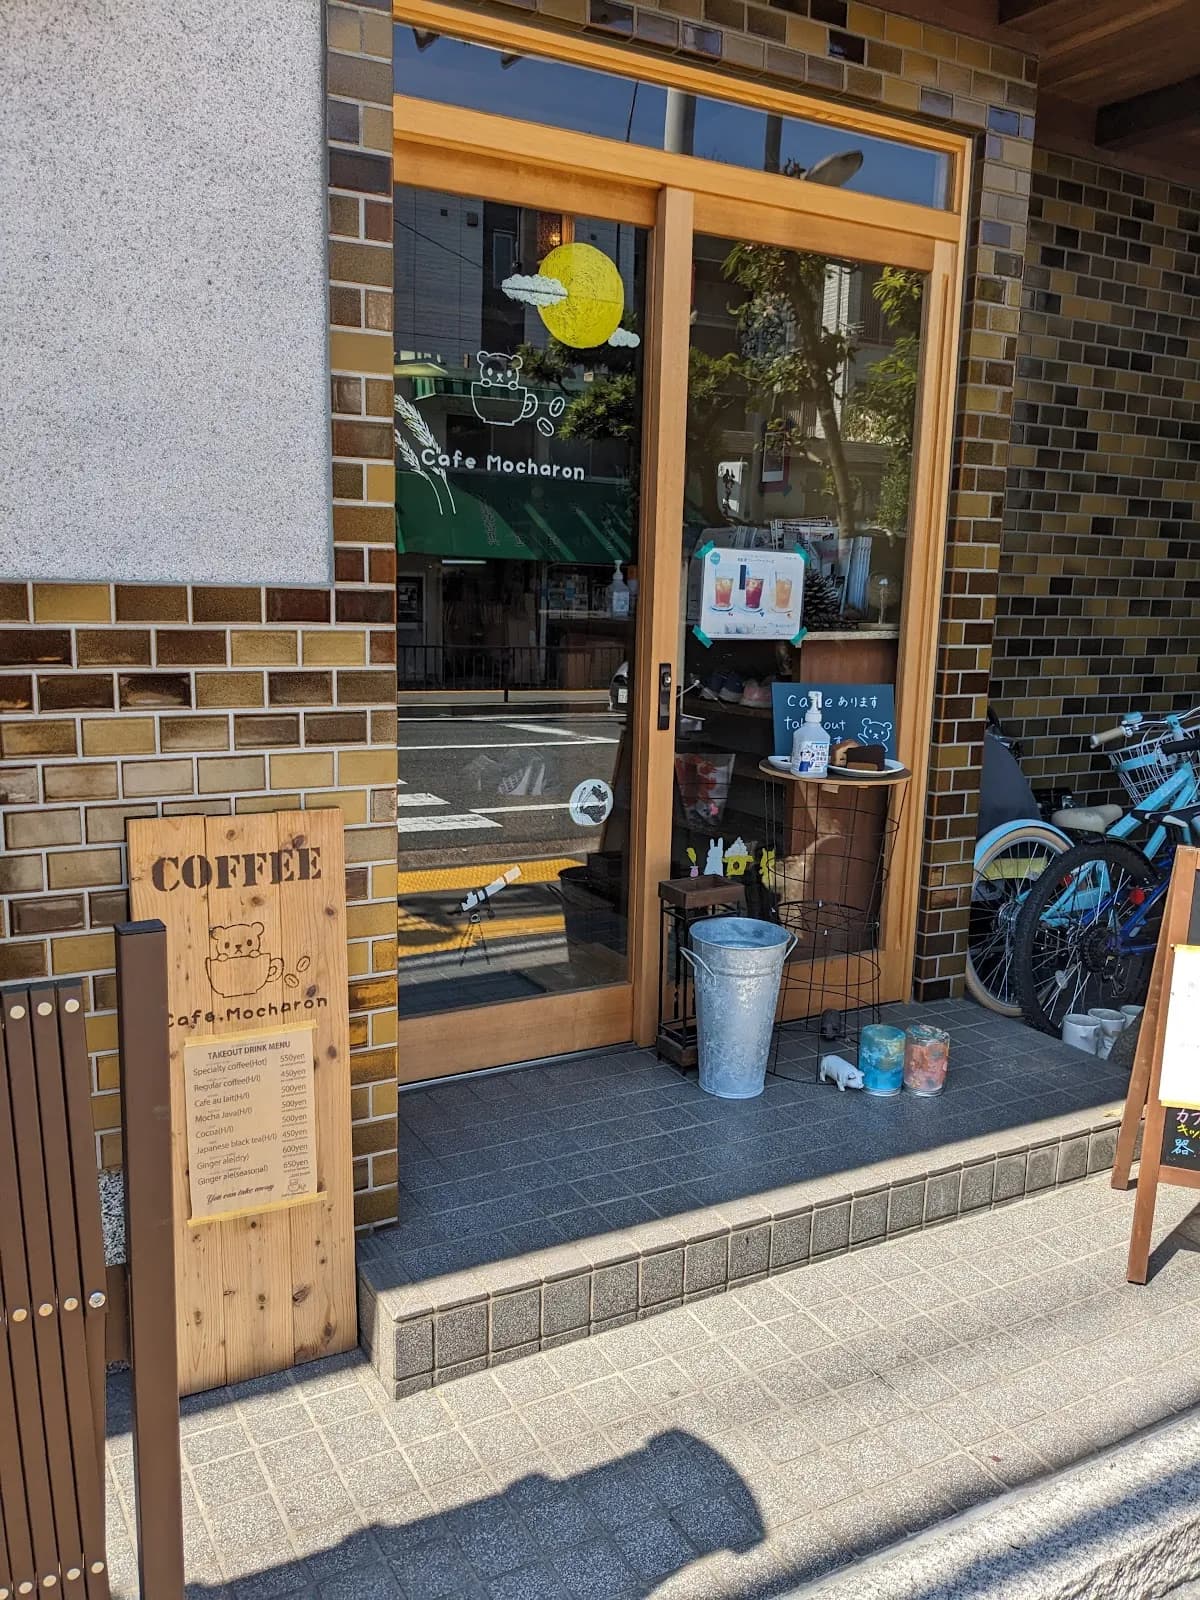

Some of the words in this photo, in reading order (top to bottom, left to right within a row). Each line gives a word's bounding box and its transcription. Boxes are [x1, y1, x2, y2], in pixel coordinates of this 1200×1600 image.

[421, 449, 477, 470] Cafe
[486, 454, 585, 481] Mocharon
[787, 694, 833, 708] Cae
[837, 695, 878, 709] あります
[823, 719, 846, 730] out
[151, 847, 322, 892] COFFEE
[208, 1048, 242, 1058] TAKEOUT
[244, 1044, 267, 1053] DRINK
[269, 1040, 290, 1050] MENU
[280, 1053, 305, 1063] 550yen
[193, 1064, 226, 1077] Specialty
[280, 1068, 306, 1079] 450yen
[193, 1081, 222, 1093] Regular
[281, 1083, 306, 1094] 500yen
[281, 1098, 307, 1109] 500yen
[195, 1112, 220, 1122] Mocha
[282, 1113, 307, 1124] 500yen
[282, 1128, 307, 1139] 450yen
[196, 1142, 229, 1155] Japanese
[231, 1138, 249, 1147] black
[283, 1143, 308, 1154] 600yen
[1171, 1138, 1195, 1155] 器
[197, 1159, 221, 1171] Ginger
[283, 1158, 308, 1169] 650yen
[198, 1175, 222, 1186] Ginger
